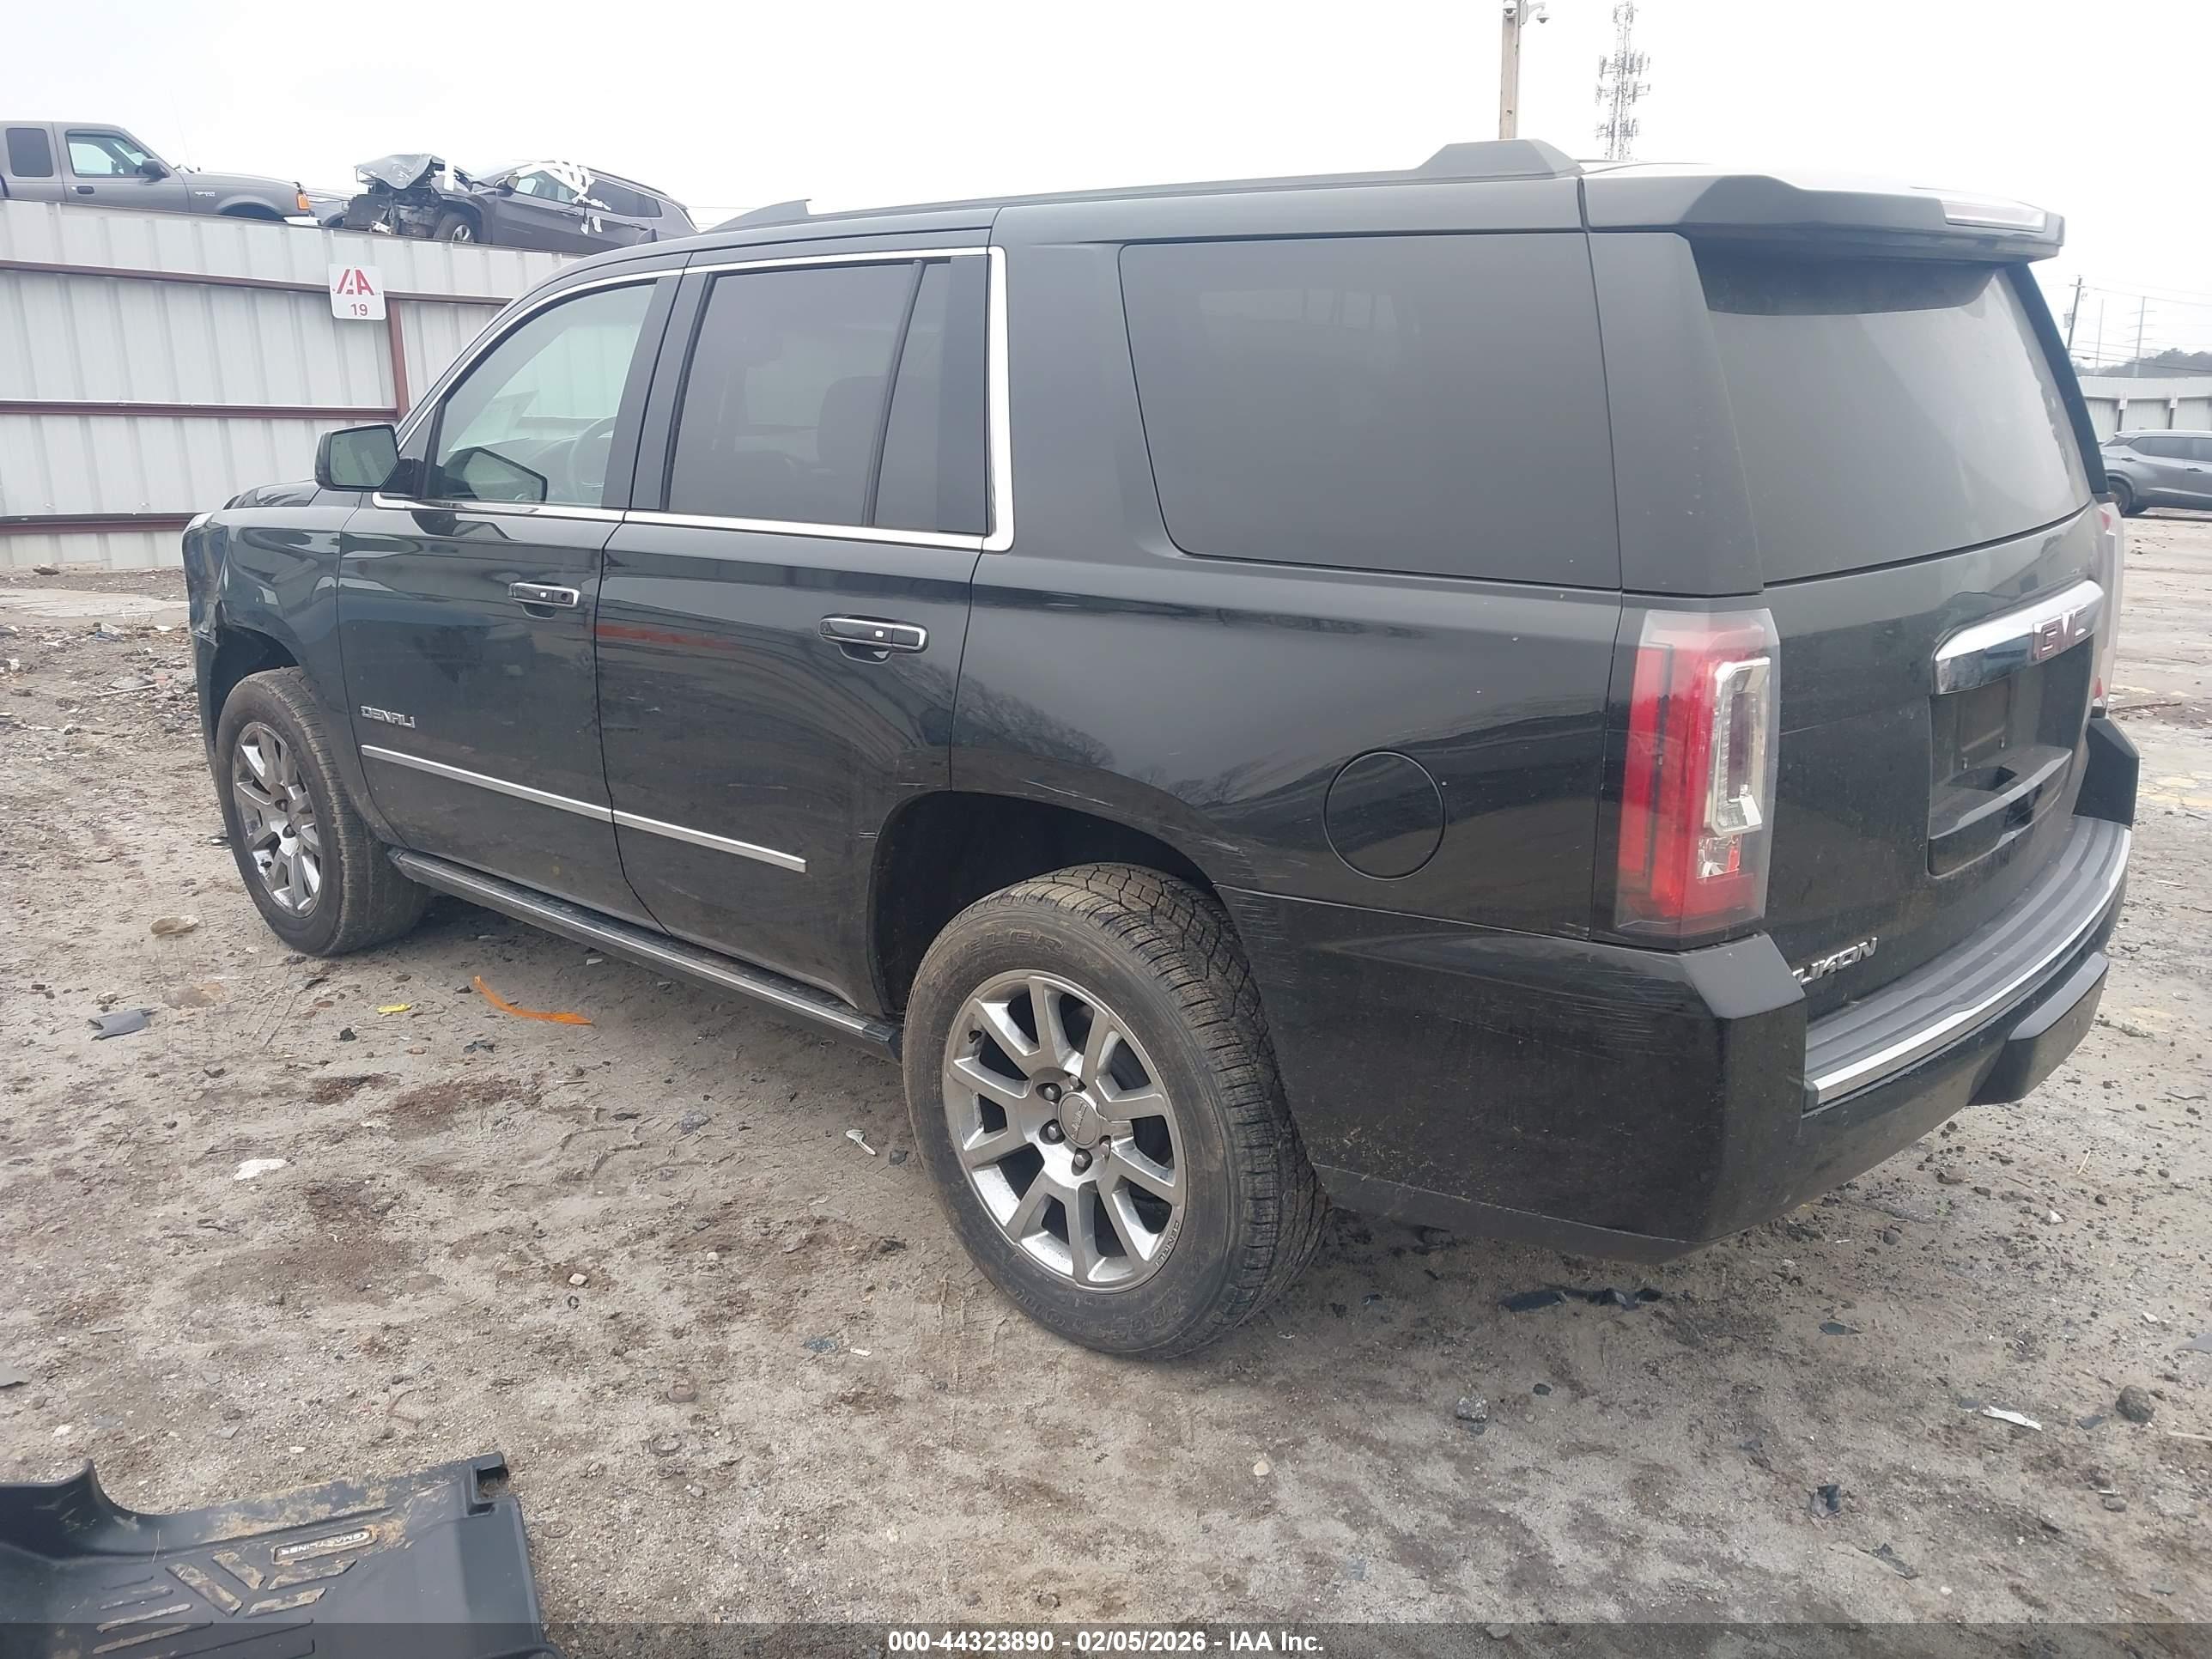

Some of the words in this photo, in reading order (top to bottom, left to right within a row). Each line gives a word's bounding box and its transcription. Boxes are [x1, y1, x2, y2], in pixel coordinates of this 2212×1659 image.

[349, 302, 368, 318] 19
[2033, 604, 2089, 661] GMC
[359, 705, 416, 729] DENALI
[1792, 936, 1879, 986] UKON
